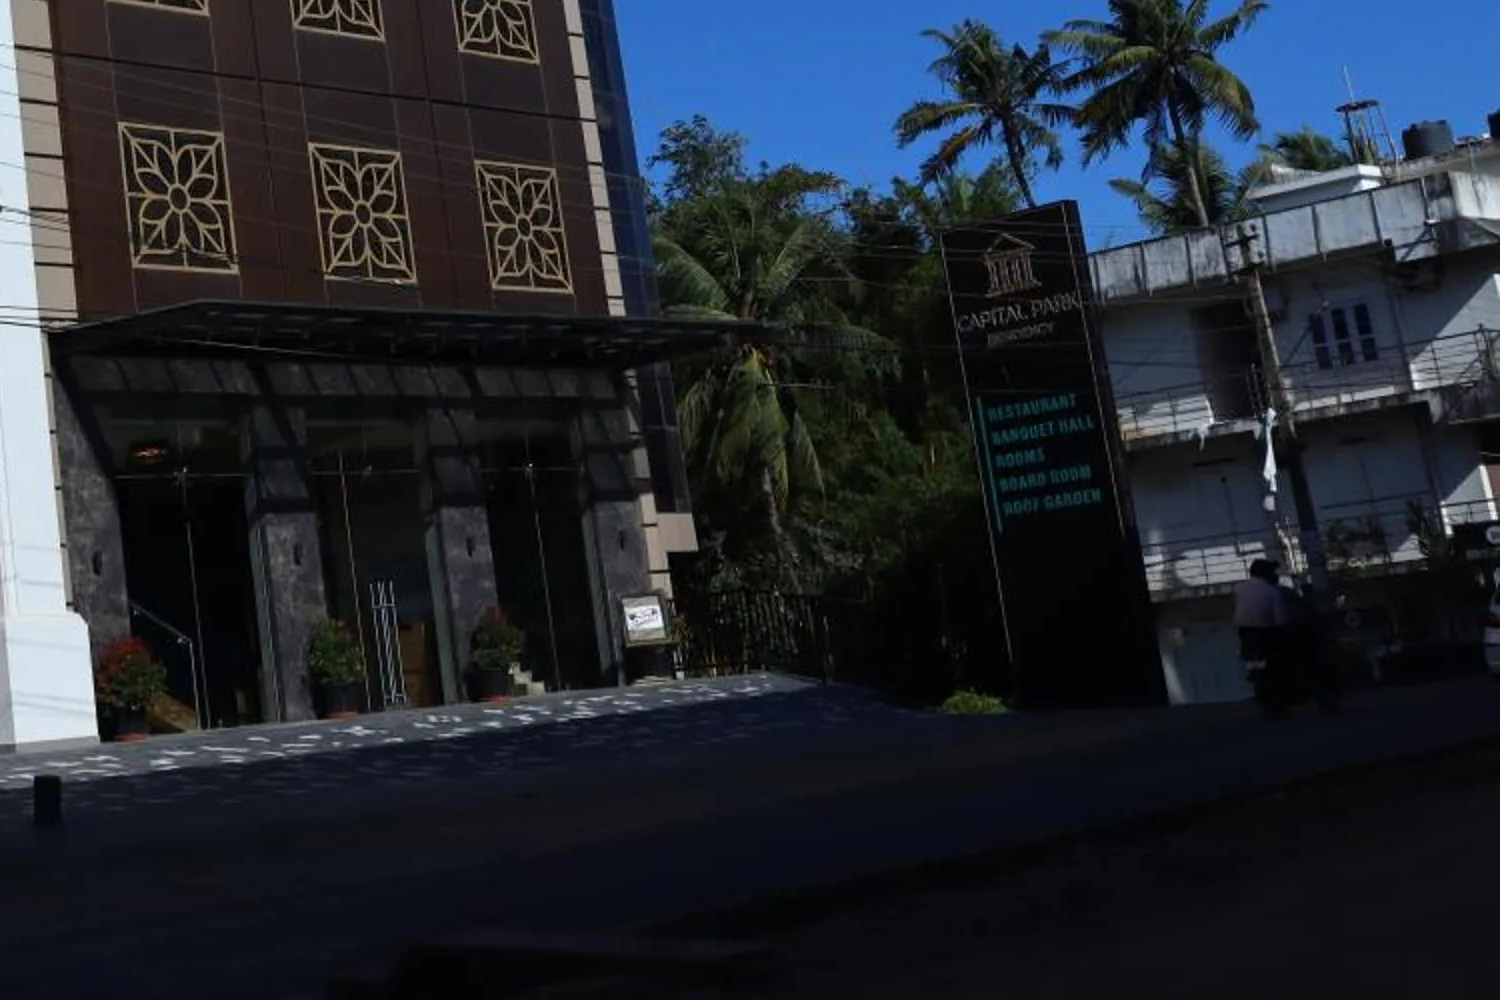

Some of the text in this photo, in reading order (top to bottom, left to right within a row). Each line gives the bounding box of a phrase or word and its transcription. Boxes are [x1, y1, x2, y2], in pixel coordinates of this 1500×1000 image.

[957, 292, 1082, 332] CAPITAL PARK
[987, 393, 1076, 421] RESTAURANT
[991, 414, 1095, 445] BANQUET HALL
[995, 447, 1045, 468] ROOMS
[998, 464, 1092, 493] BOARD ROOM
[1003, 487, 1102, 516] ROOF GARDEN
